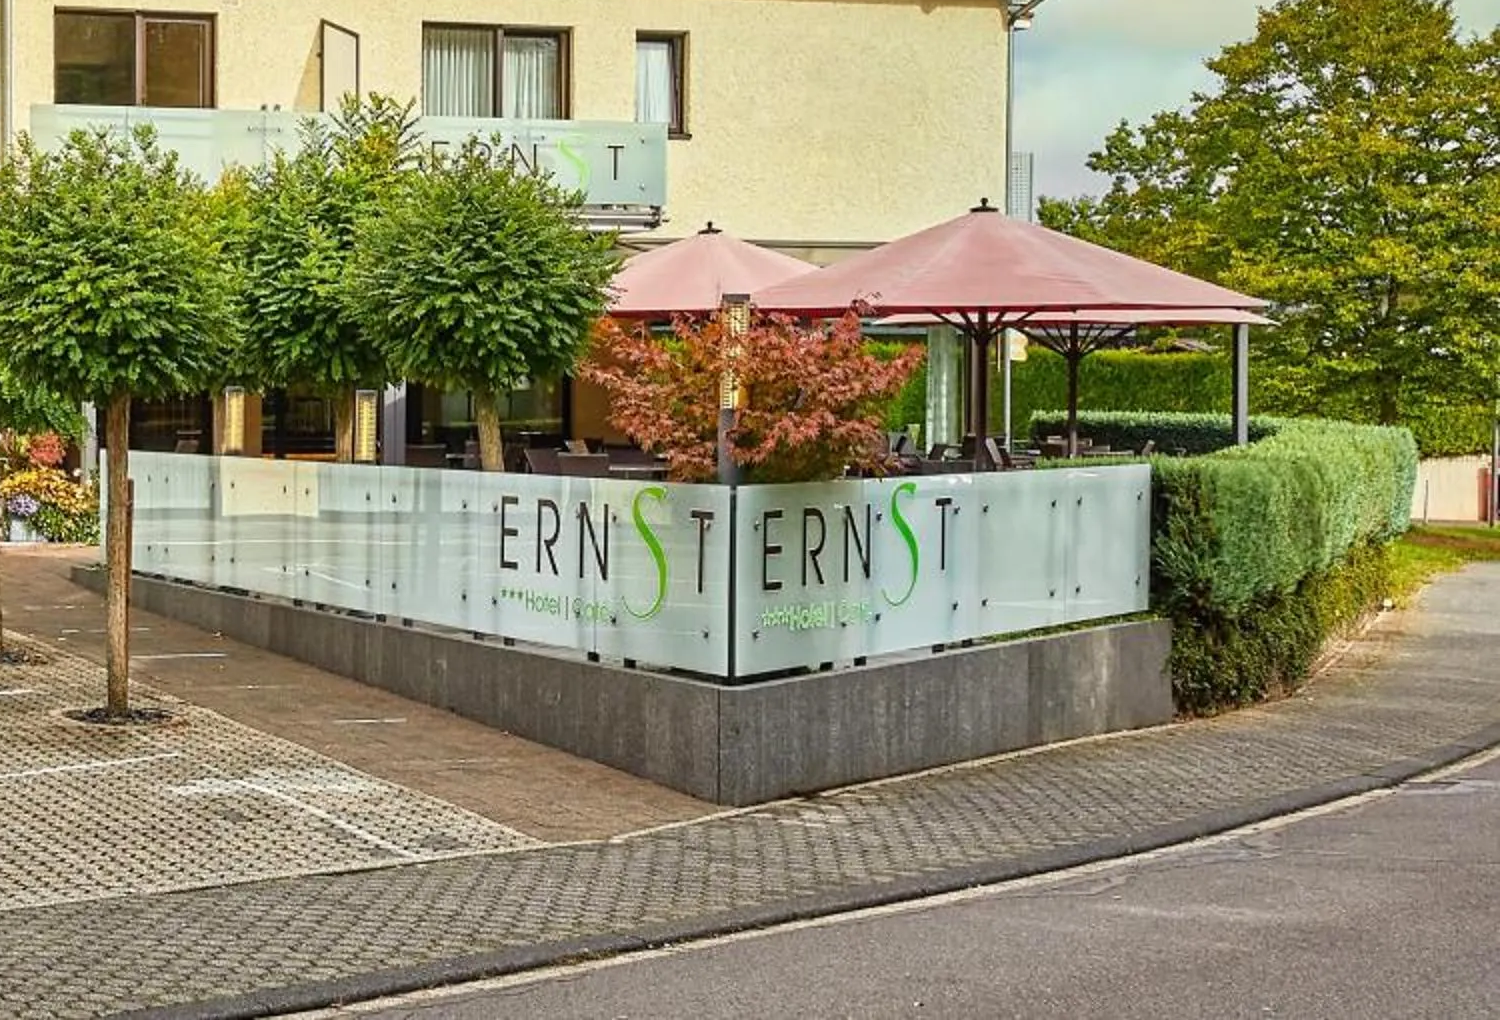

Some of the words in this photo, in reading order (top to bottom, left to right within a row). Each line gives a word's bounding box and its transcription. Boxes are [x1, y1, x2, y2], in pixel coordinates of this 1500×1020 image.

[500, 485, 714, 620] ERNST
[526, 589, 561, 615] Hotel
[762, 482, 953, 607] ERNST
